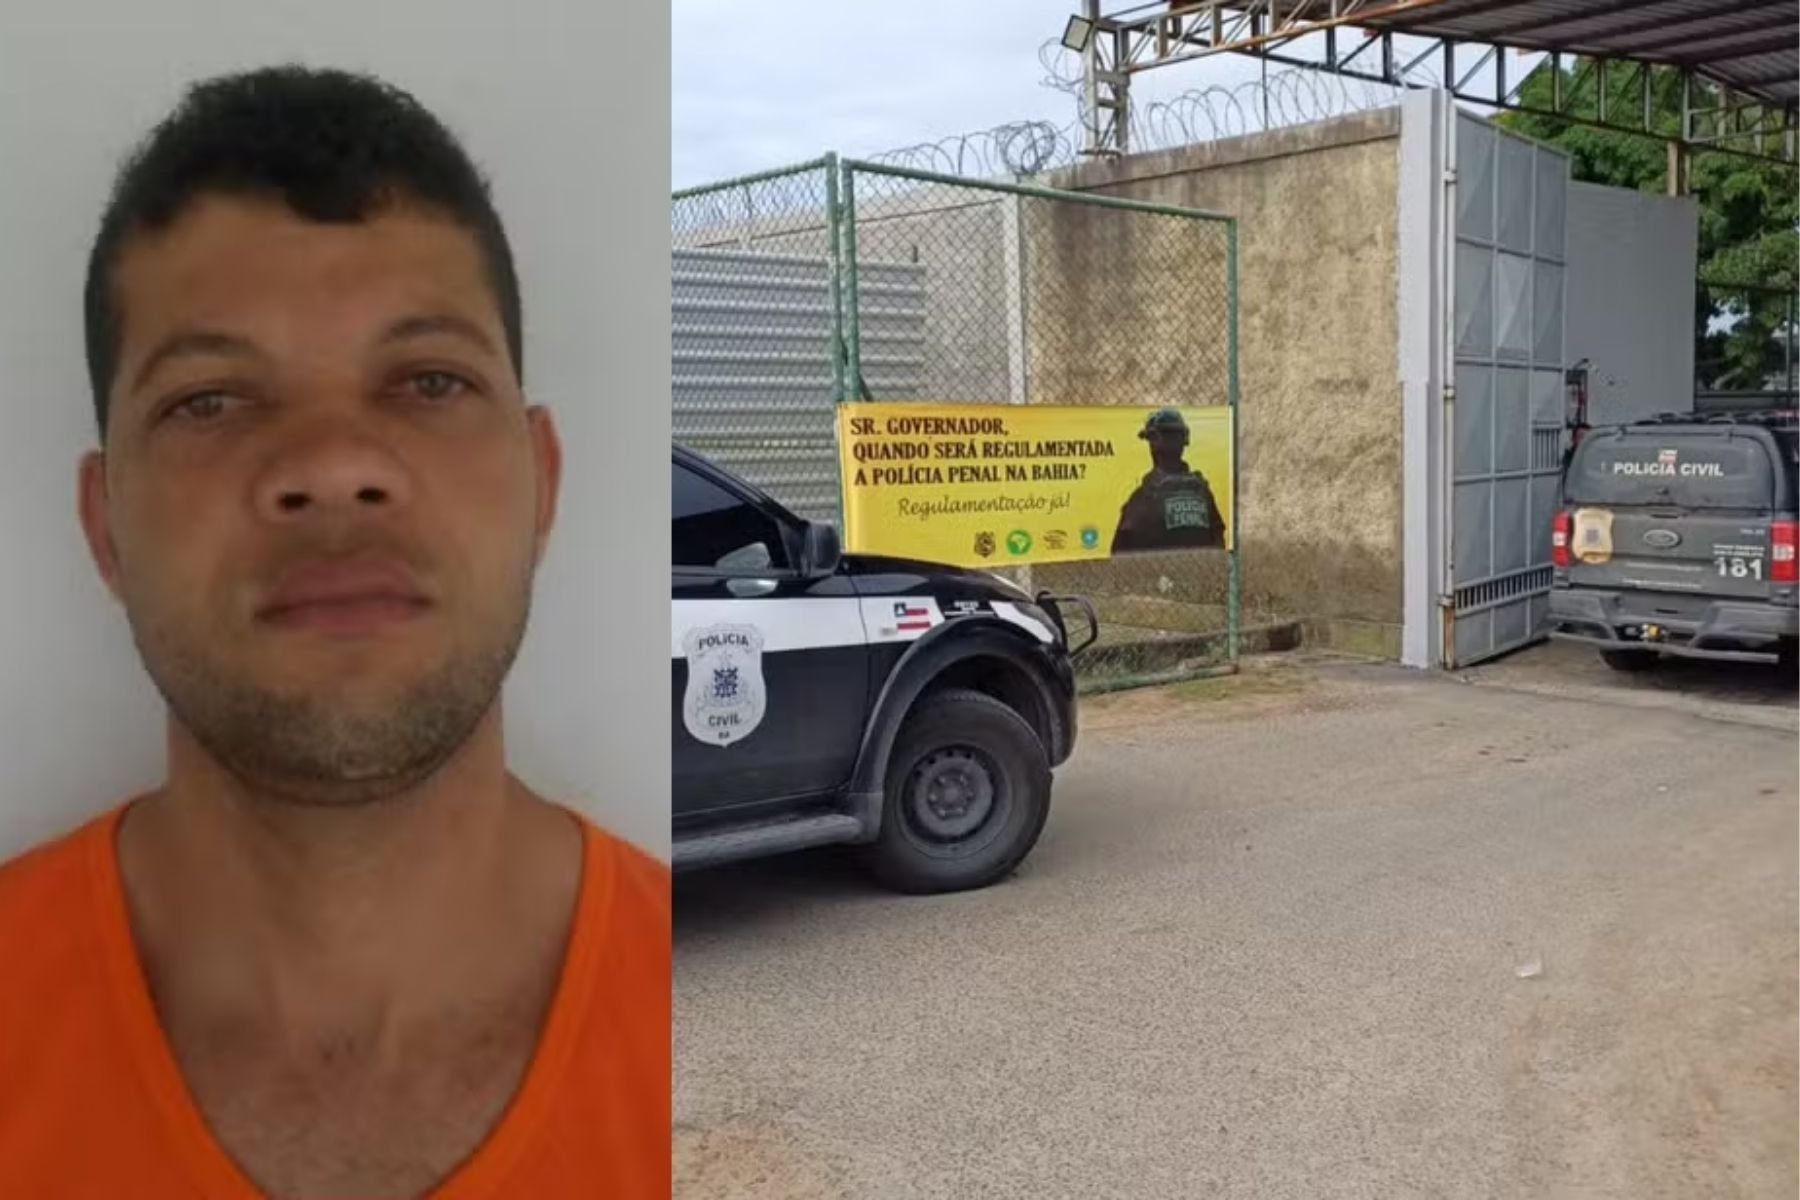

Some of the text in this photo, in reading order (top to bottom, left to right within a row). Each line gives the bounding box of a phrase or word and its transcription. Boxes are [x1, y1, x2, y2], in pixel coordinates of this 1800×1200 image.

[851, 418, 1009, 436] SR. GOVERNADOR,
[853, 439, 1114, 461] QUANDO SERÁ REGULAMENTADA
[855, 463, 1086, 485] A POLÍCIA PENAL NA BAHIA?
[1681, 463, 1724, 477] CIVIL
[898, 492, 1071, 518] Regulamentação já!
[1714, 557, 1763, 581] 181
[708, 713, 740, 727] CIVIL
